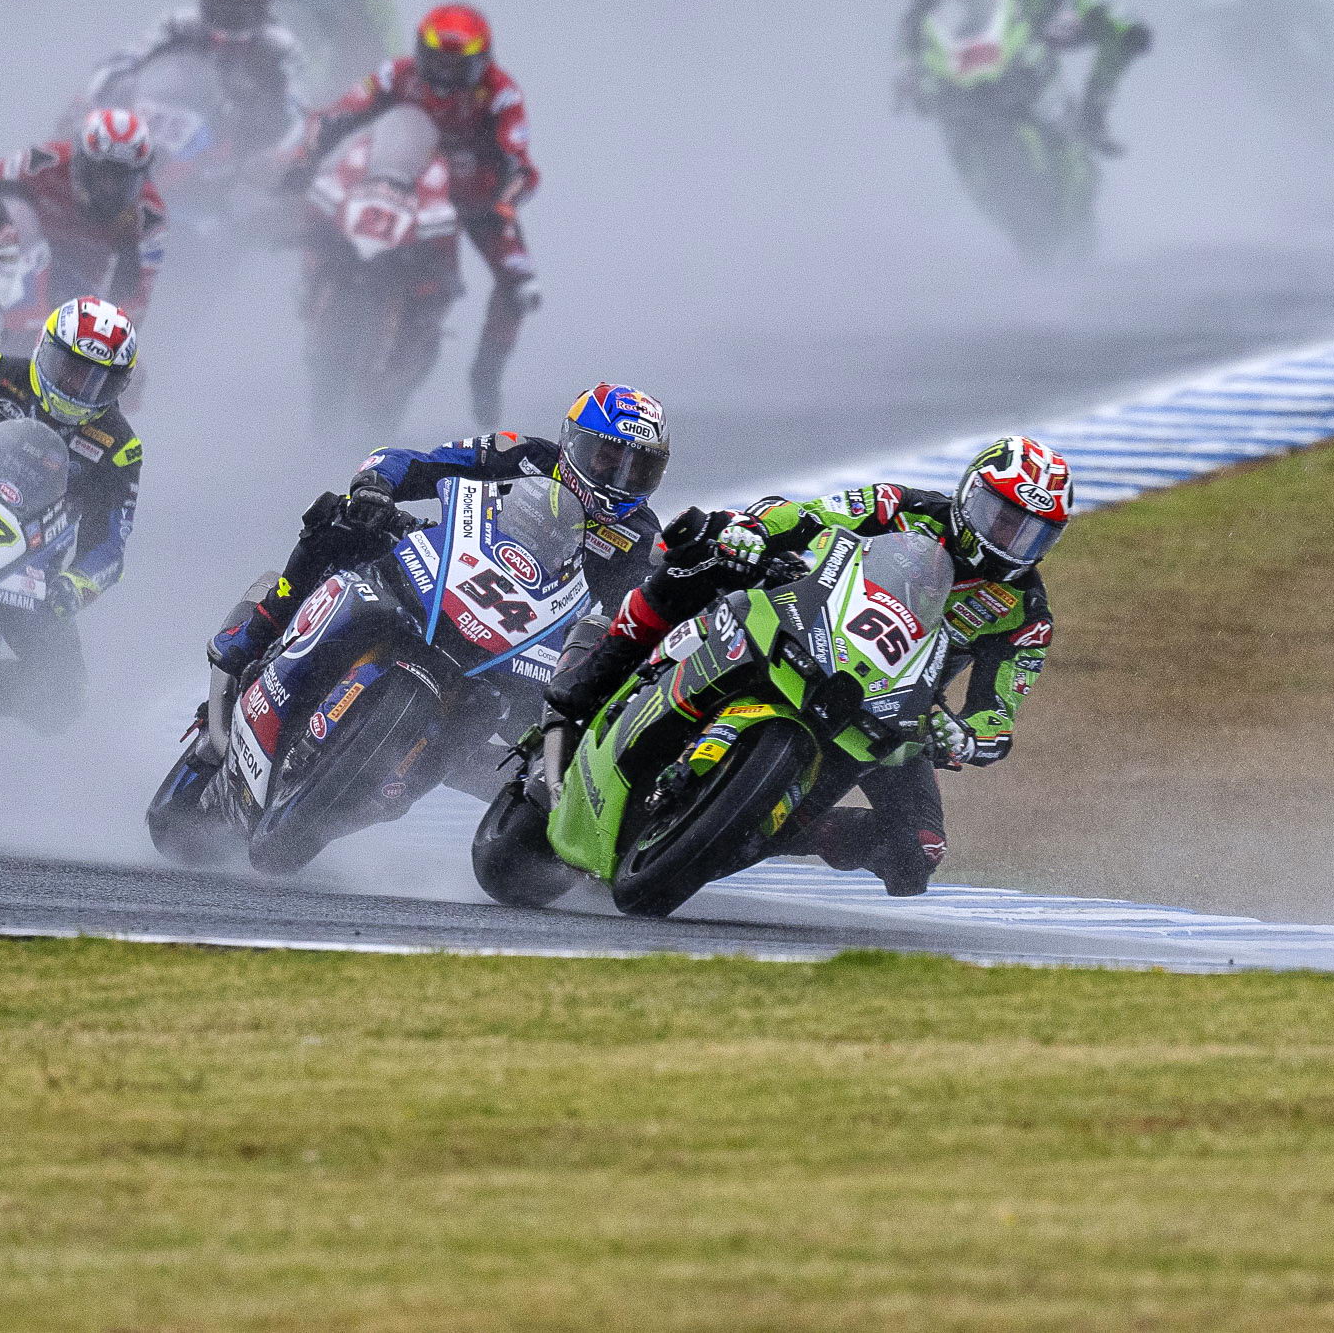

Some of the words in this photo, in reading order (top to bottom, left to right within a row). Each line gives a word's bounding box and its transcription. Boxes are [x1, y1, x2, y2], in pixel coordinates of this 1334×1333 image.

[80, 340, 109, 359] Arai
[615, 400, 639, 411] Red
[642, 406, 660, 420] Bull
[598, 433, 621, 444] GIVES
[626, 440, 642, 450] YOU
[621, 421, 651, 438] SHOEI
[1021, 487, 1054, 508] Arai
[462, 485, 477, 539] PROMETEON
[589, 536, 612, 554] YAMAHA
[399, 547, 434, 595] YAMAHA
[505, 549, 534, 579] PATA
[818, 536, 855, 590] Kawasaki
[456, 568, 538, 634] 54
[550, 580, 584, 615] PROMETEON
[457, 611, 492, 641] BMP
[715, 603, 738, 642] elf
[870, 591, 919, 635] SHOWA
[954, 603, 984, 628] SHOWA
[458, 623, 479, 643] TAPPI
[835, 637, 847, 654] elf
[846, 608, 910, 667] 65
[512, 657, 552, 684] YAMAHA
[922, 627, 950, 687] Kawasaki
[248, 684, 270, 716] BMP
[869, 680, 884, 693] elf
[727, 705, 765, 715] PIRELLI
